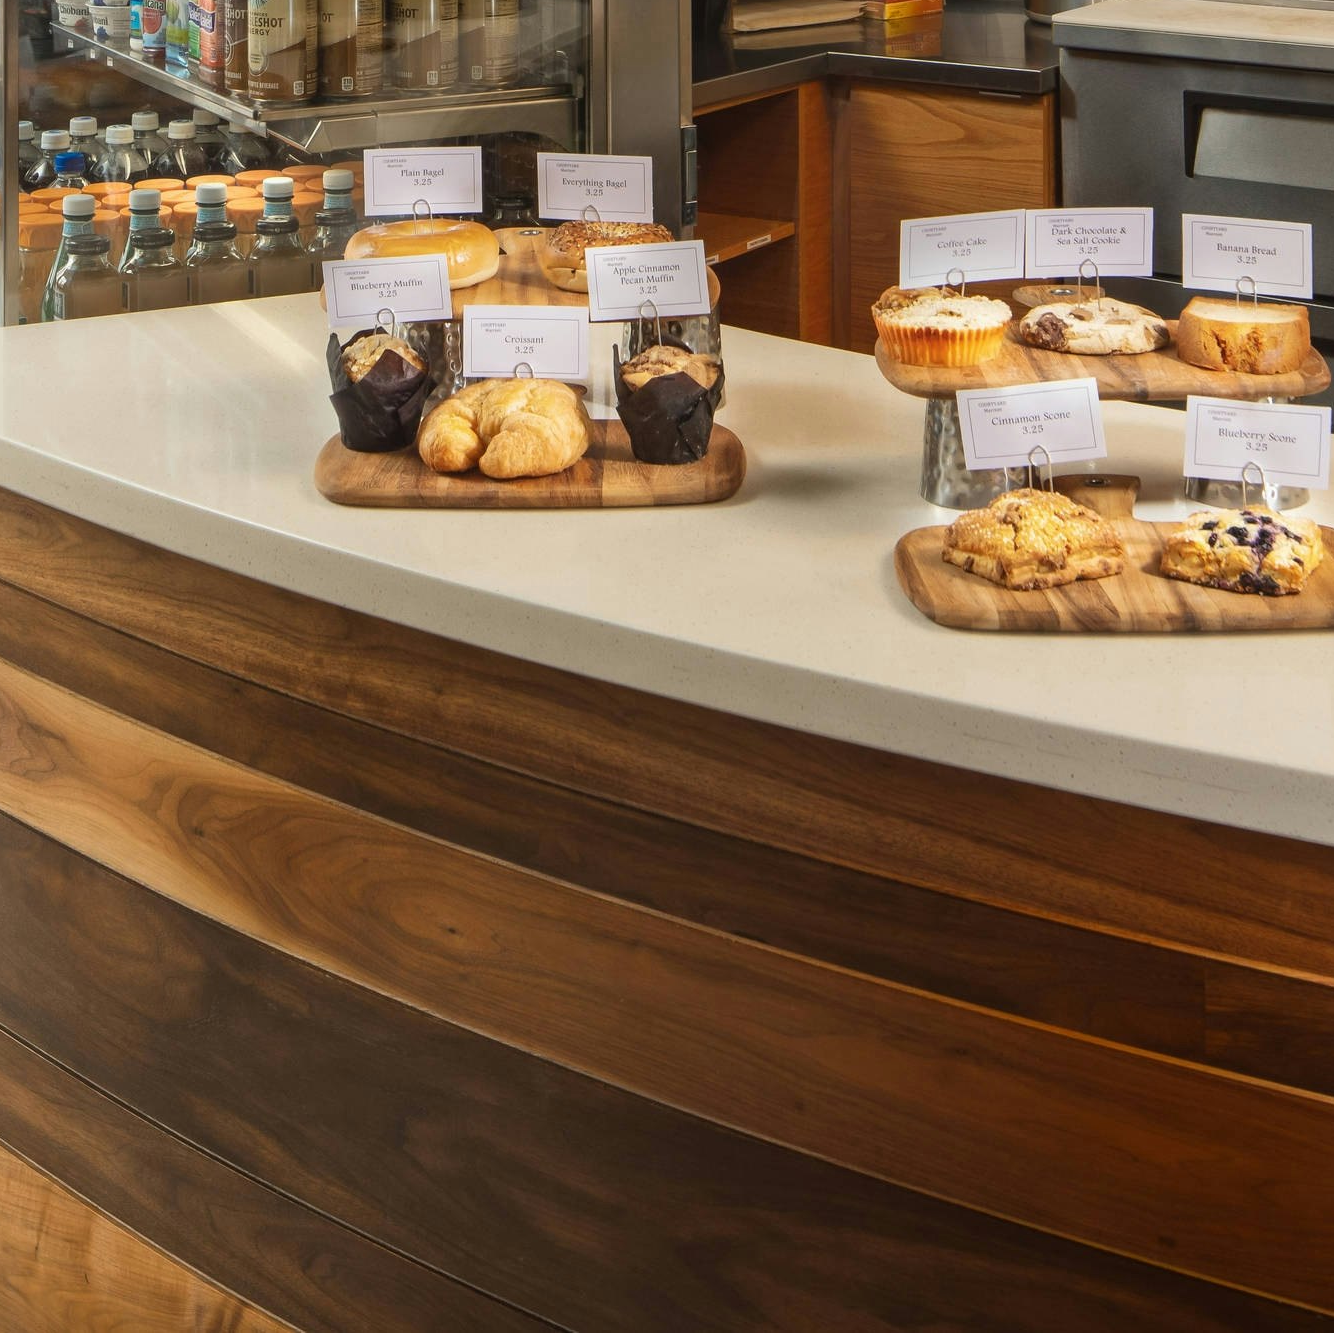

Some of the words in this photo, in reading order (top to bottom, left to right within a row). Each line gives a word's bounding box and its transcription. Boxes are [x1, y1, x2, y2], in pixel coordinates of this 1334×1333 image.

[401, 169, 421, 177] Plain
[423, 168, 444, 178] Bagel
[413, 178, 432, 186] 3.25
[562, 178, 604, 189] Everything
[606, 179, 627, 190] Bagel
[1051, 226, 1073, 235] Dark
[1075, 226, 1118, 235] Chocolate
[1119, 226, 1127, 234] &
[937, 239, 964, 248] Coffee
[966, 237, 987, 246] Cake
[1057, 236, 1071, 244] Sea
[1073, 236, 1089, 244] Salt
[1091, 235, 1121, 244] Cookie
[1078, 245, 1099, 255] 3.25
[1217, 244, 1249, 254] Banana
[1252, 246, 1277, 255] Bread
[613, 265, 636, 275] Apple
[638, 264, 681, 272] Cinnamon
[621, 276, 644, 284] Pecan
[646, 274, 674, 282] Muffin
[350, 281, 392, 291] Blueberry
[394, 279, 423, 288] Muffin
[504, 335, 544, 343] Croissant
[514, 345, 534, 354] 3.25
[991, 416, 1041, 425] Cinnamon
[1043, 412, 1070, 421] Scone
[1022, 424, 1044, 435] 3.25
[1218, 428, 1266, 443] Blueberry
[1268, 432, 1297, 443] Scone
